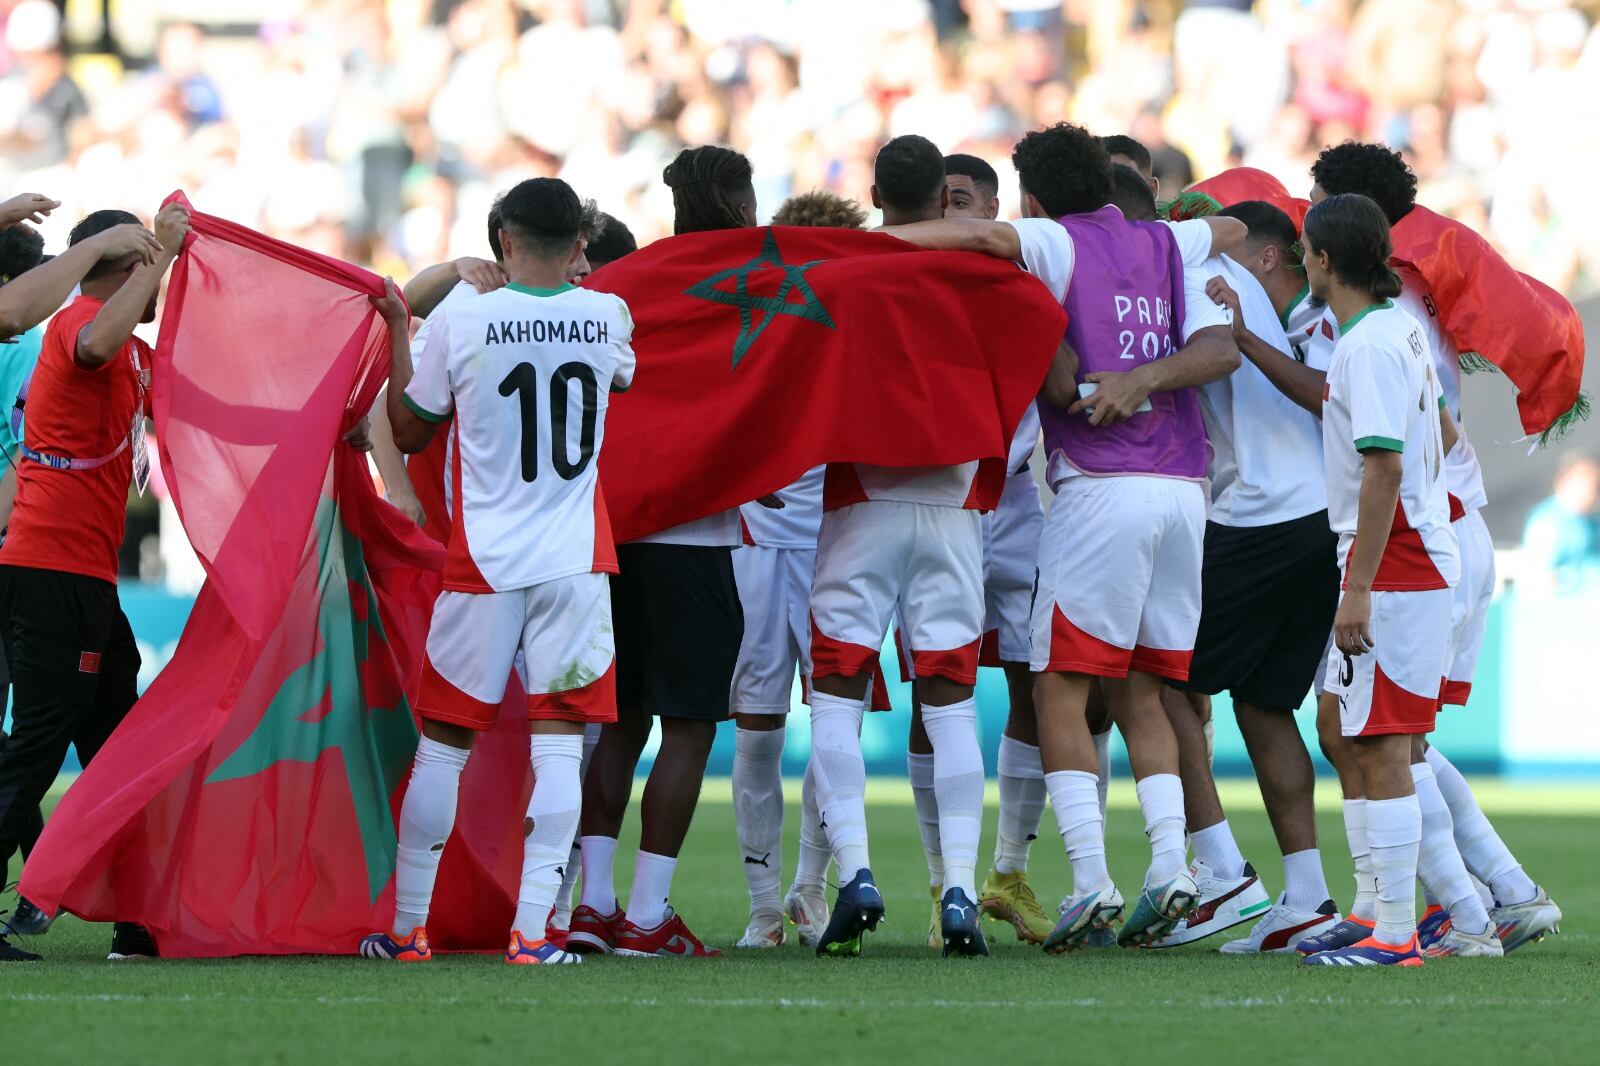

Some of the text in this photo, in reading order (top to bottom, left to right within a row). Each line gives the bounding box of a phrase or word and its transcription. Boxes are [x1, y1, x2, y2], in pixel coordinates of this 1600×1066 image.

[485, 319, 608, 346] AKHOMACH
[1119, 329, 1177, 360] 202
[498, 361, 598, 483] 10
